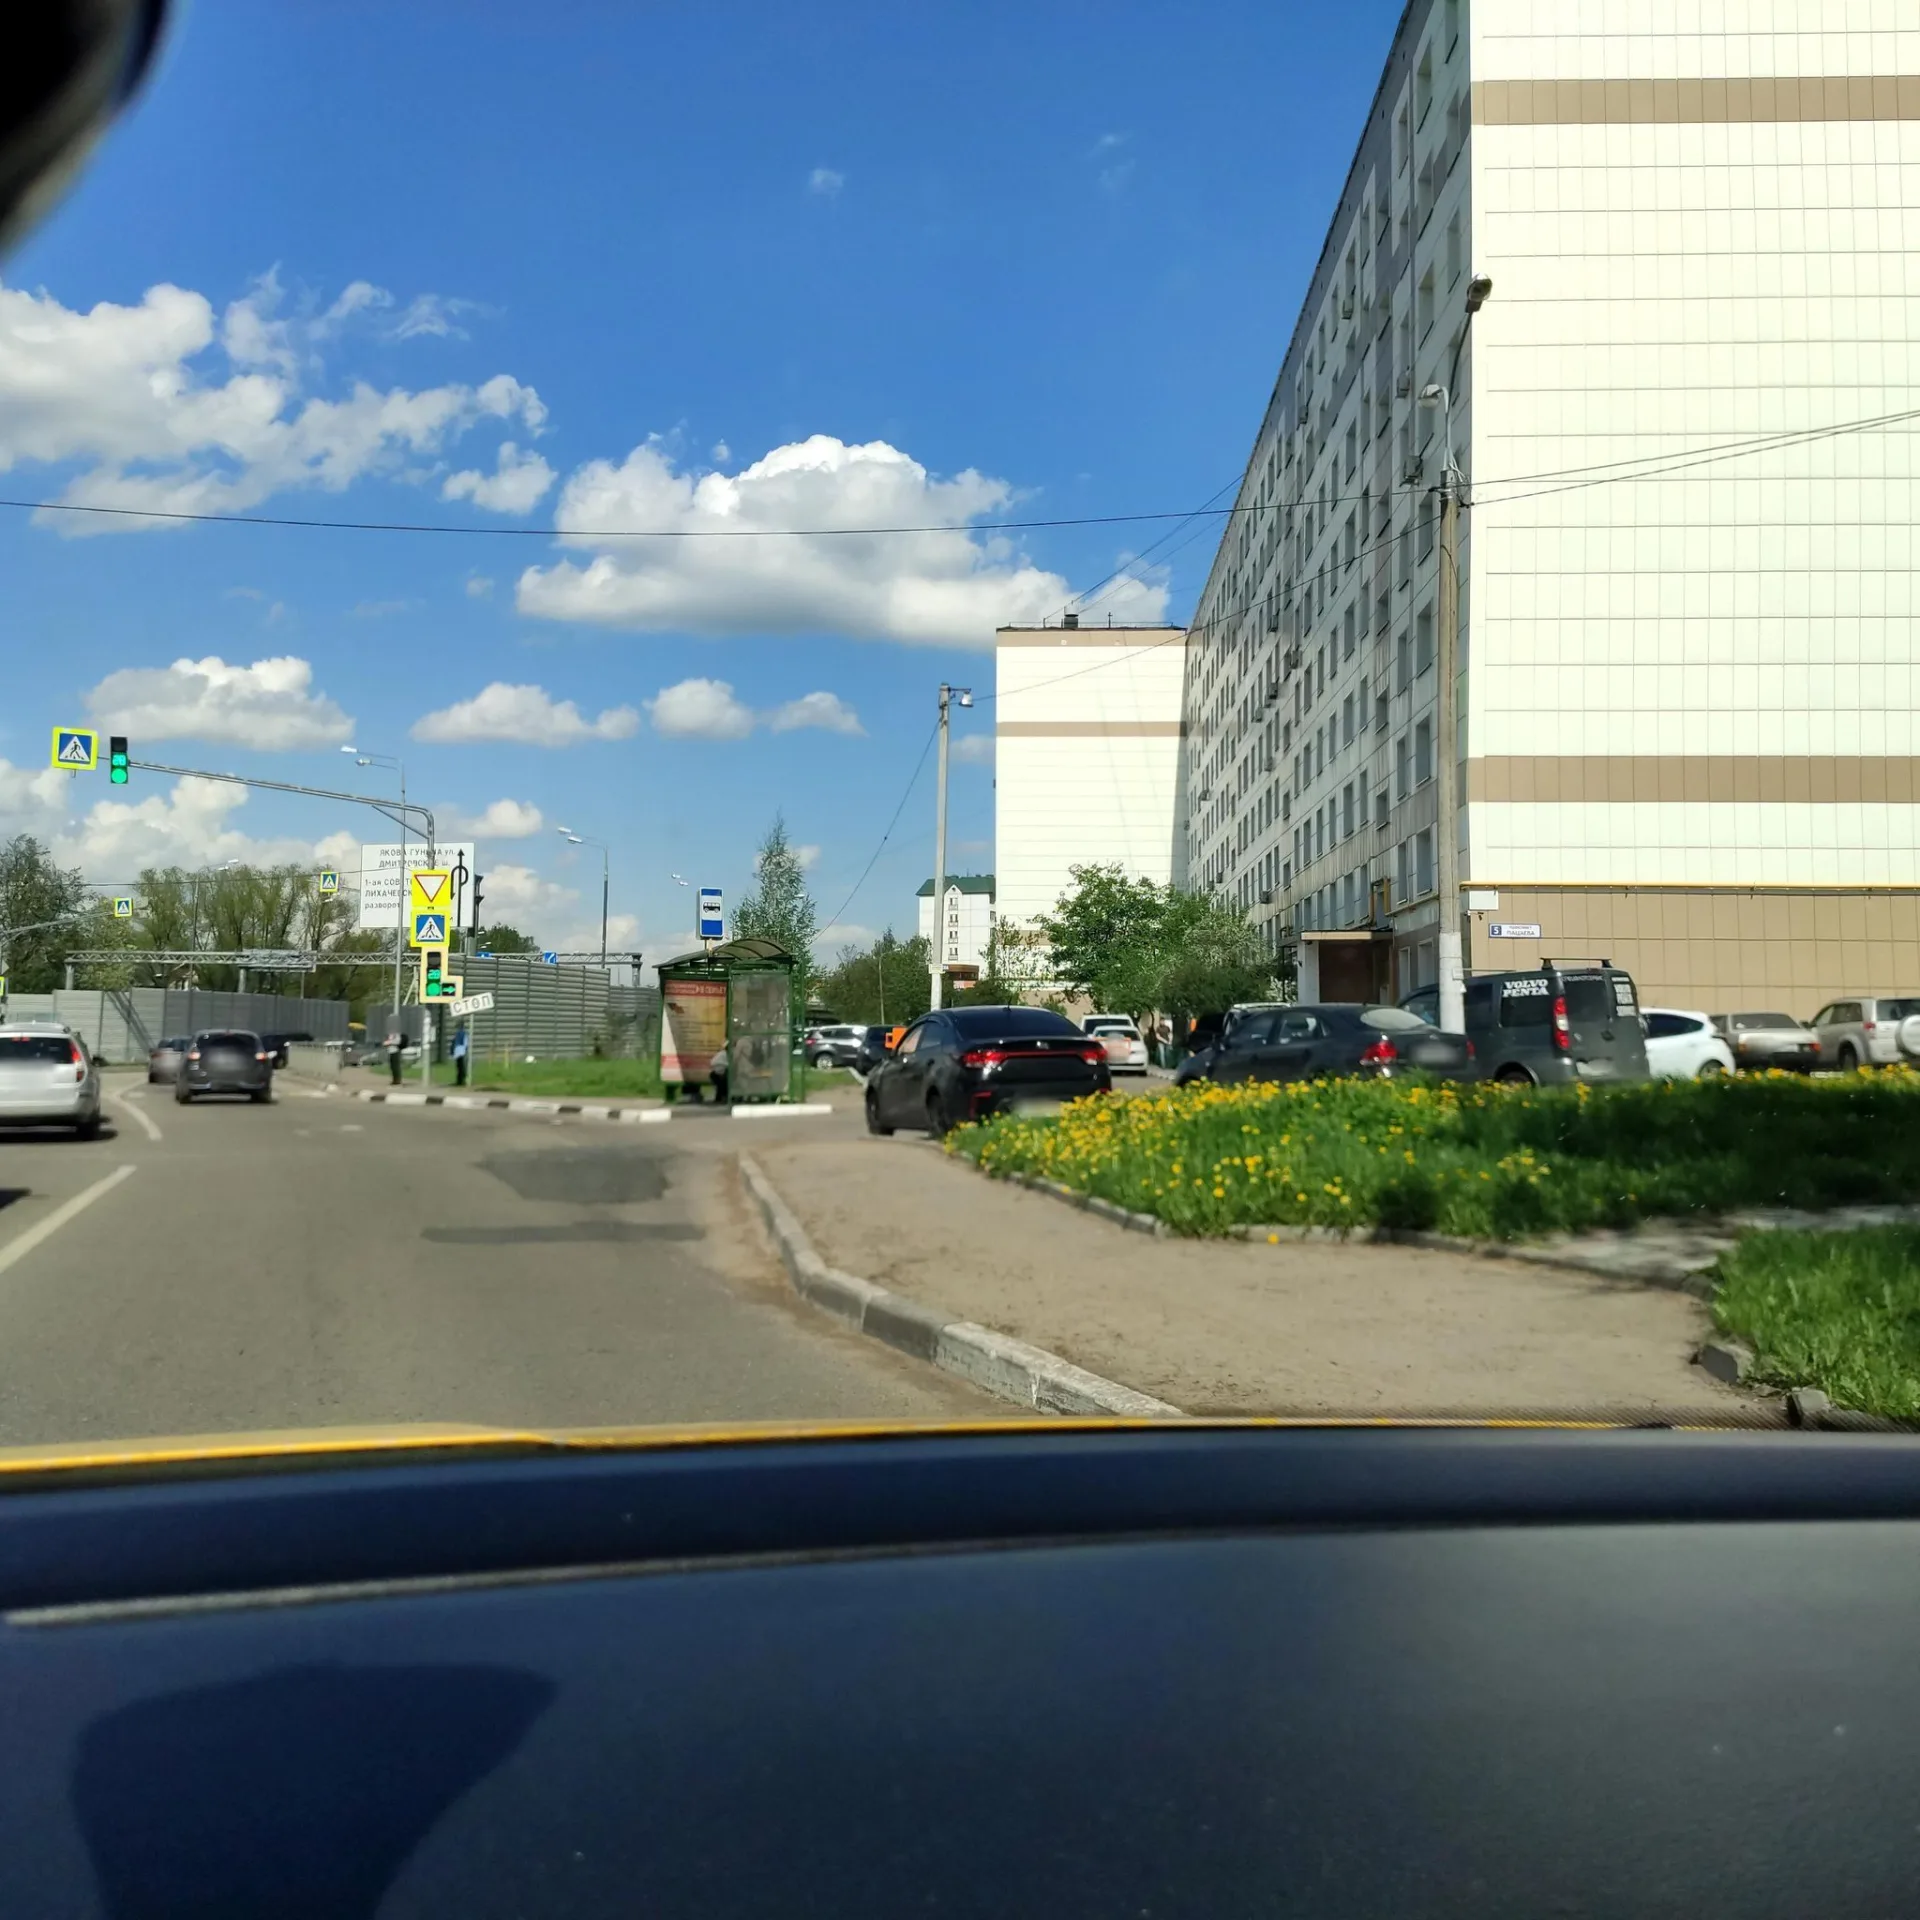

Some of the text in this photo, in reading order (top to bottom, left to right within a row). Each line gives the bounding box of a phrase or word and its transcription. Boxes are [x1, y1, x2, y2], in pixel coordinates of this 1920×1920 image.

[410, 848, 442, 856] ГУННА
[379, 859, 439, 868] ДМИТРОВСКЕ
[1504, 979, 1549, 989] VOLVO
[1502, 987, 1550, 998] PENTA
[453, 995, 491, 1013] СТОП
